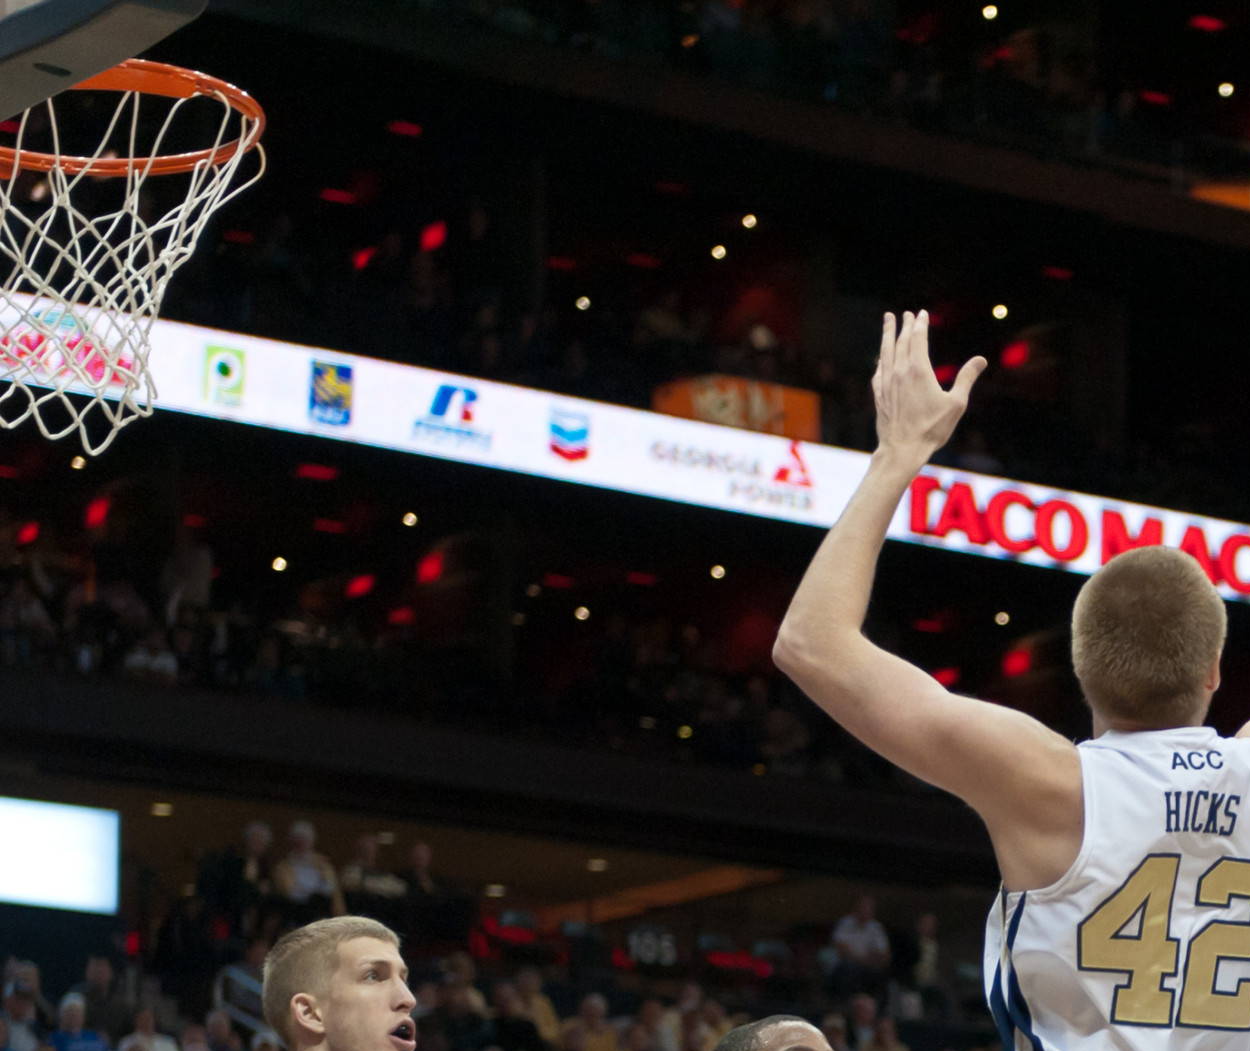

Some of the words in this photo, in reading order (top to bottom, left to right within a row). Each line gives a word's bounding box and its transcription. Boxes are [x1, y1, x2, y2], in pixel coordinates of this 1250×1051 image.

[909, 473, 1089, 562] TACO
[1171, 750, 1224, 770] ACC
[1164, 790, 1241, 836] HICKS
